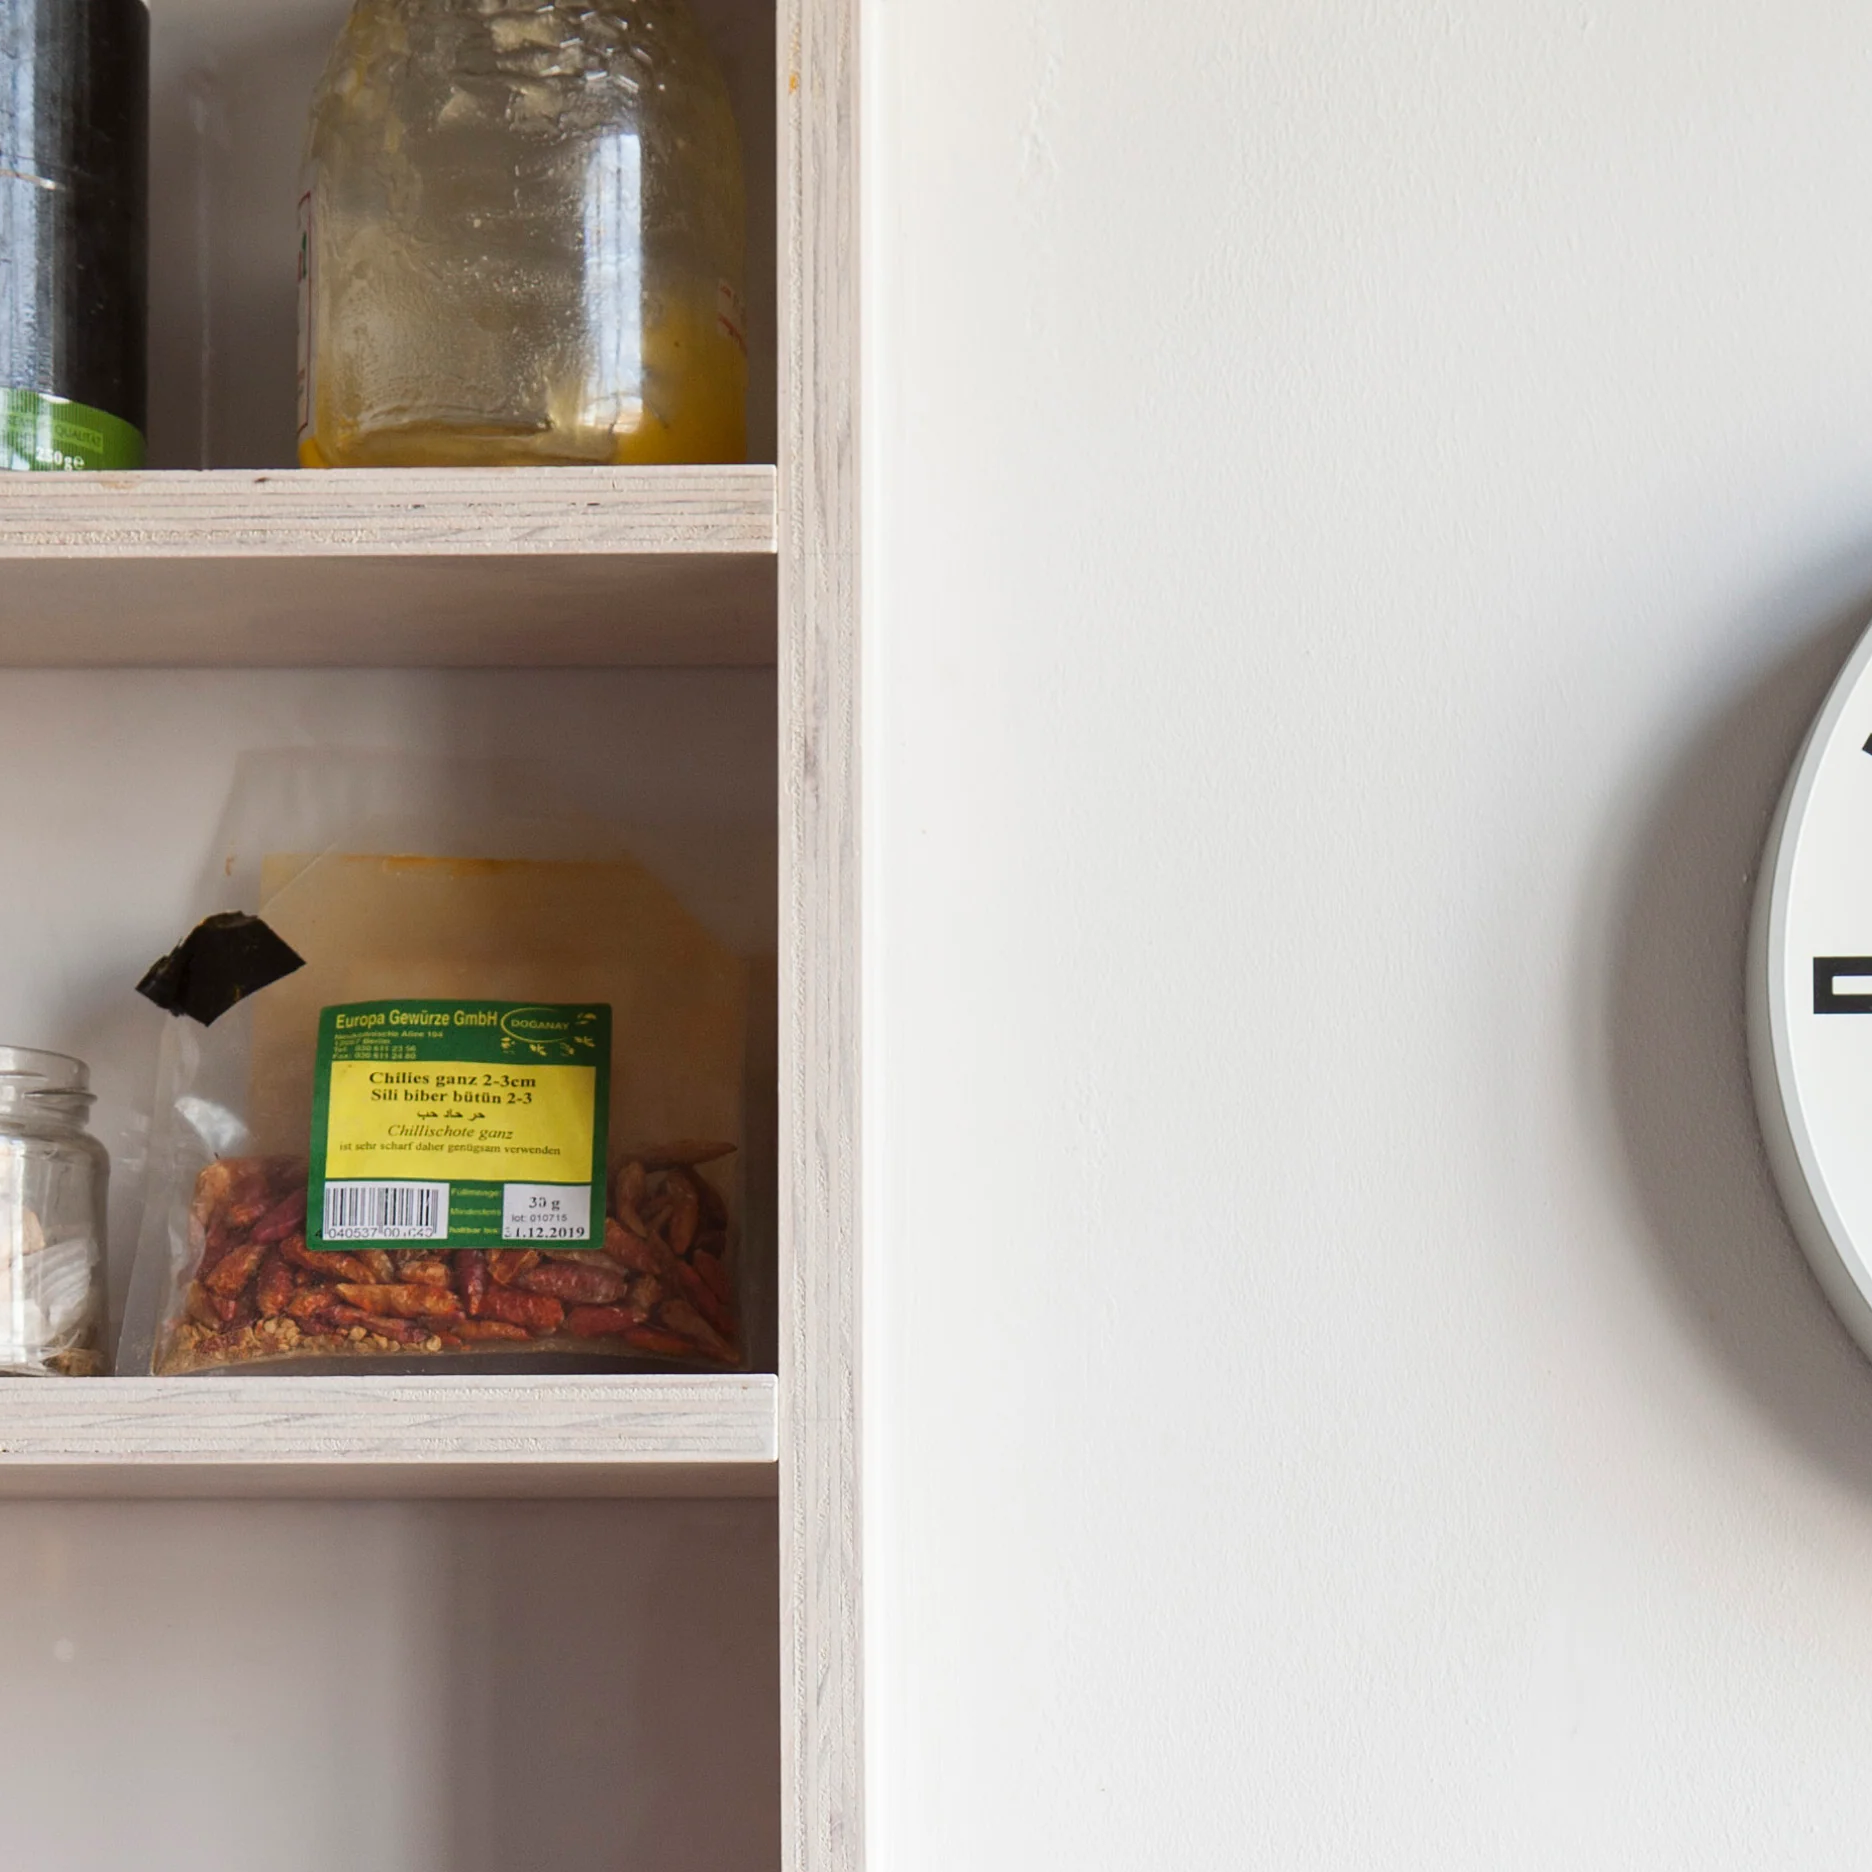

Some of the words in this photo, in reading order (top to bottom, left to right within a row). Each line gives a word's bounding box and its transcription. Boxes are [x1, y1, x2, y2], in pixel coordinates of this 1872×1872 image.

[336, 1010, 385, 1030] Europa
[389, 1009, 449, 1029] Gewürze
[453, 1010, 498, 1027] GmbH
[369, 1071, 429, 1085] Chilies
[435, 1075, 478, 1088] ganz
[482, 1074, 536, 1088] 2-3cm
[370, 1088, 398, 1102] Sili
[404, 1088, 448, 1102] biber
[453, 1090, 501, 1104] bütün
[507, 1092, 532, 1105] 2-3
[388, 1124, 475, 1138] Chillischote
[478, 1129, 514, 1140] ganz
[339, 1142, 353, 1151] ist
[355, 1142, 376, 1151] sehr
[380, 1141, 413, 1151] scharf
[415, 1141, 445, 1151] daher
[447, 1143, 501, 1154] genügsam
[503, 1146, 561, 1156] verwenden
[551, 1199, 561, 1211] g
[328, 1227, 378, 1239] 040537
